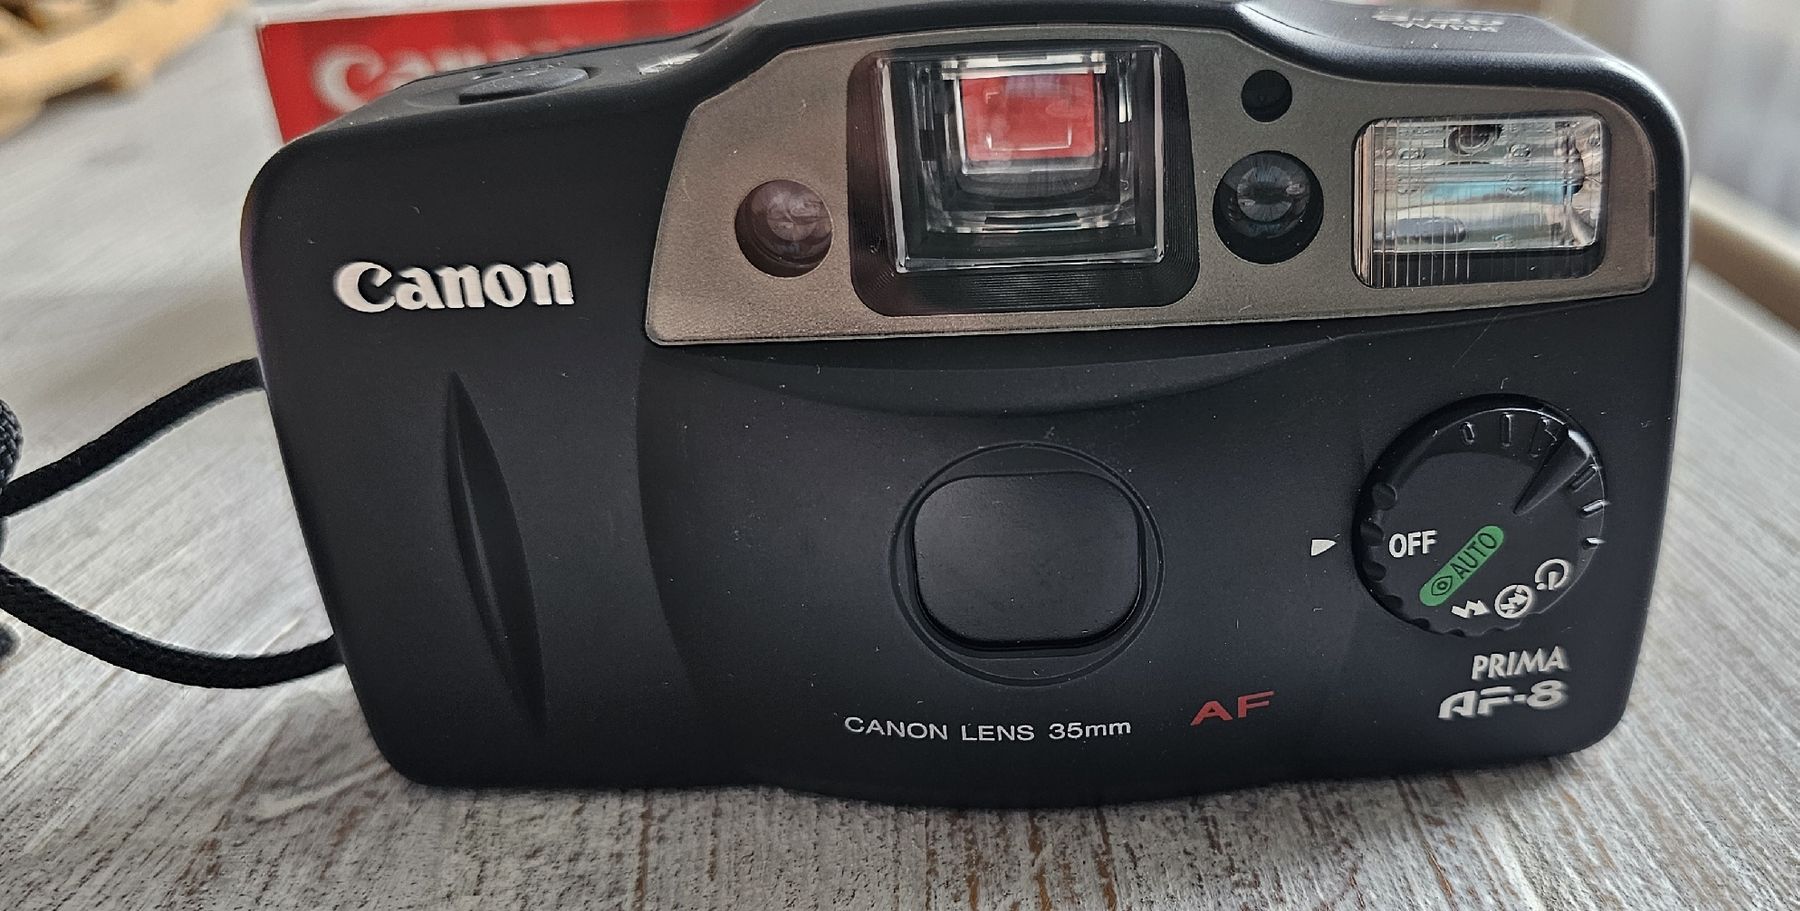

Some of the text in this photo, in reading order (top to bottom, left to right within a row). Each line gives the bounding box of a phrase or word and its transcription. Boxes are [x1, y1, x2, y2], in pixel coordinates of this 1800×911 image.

[333, 261, 575, 313] Canon
[1389, 530, 1438, 558] OFF
[1449, 531, 1499, 580] AUTO
[1471, 646, 1570, 681] PRIMA
[1190, 691, 1275, 726] AF
[1438, 679, 1567, 719] AF-8
[844, 716, 1132, 742] CANON LENS 35mm
